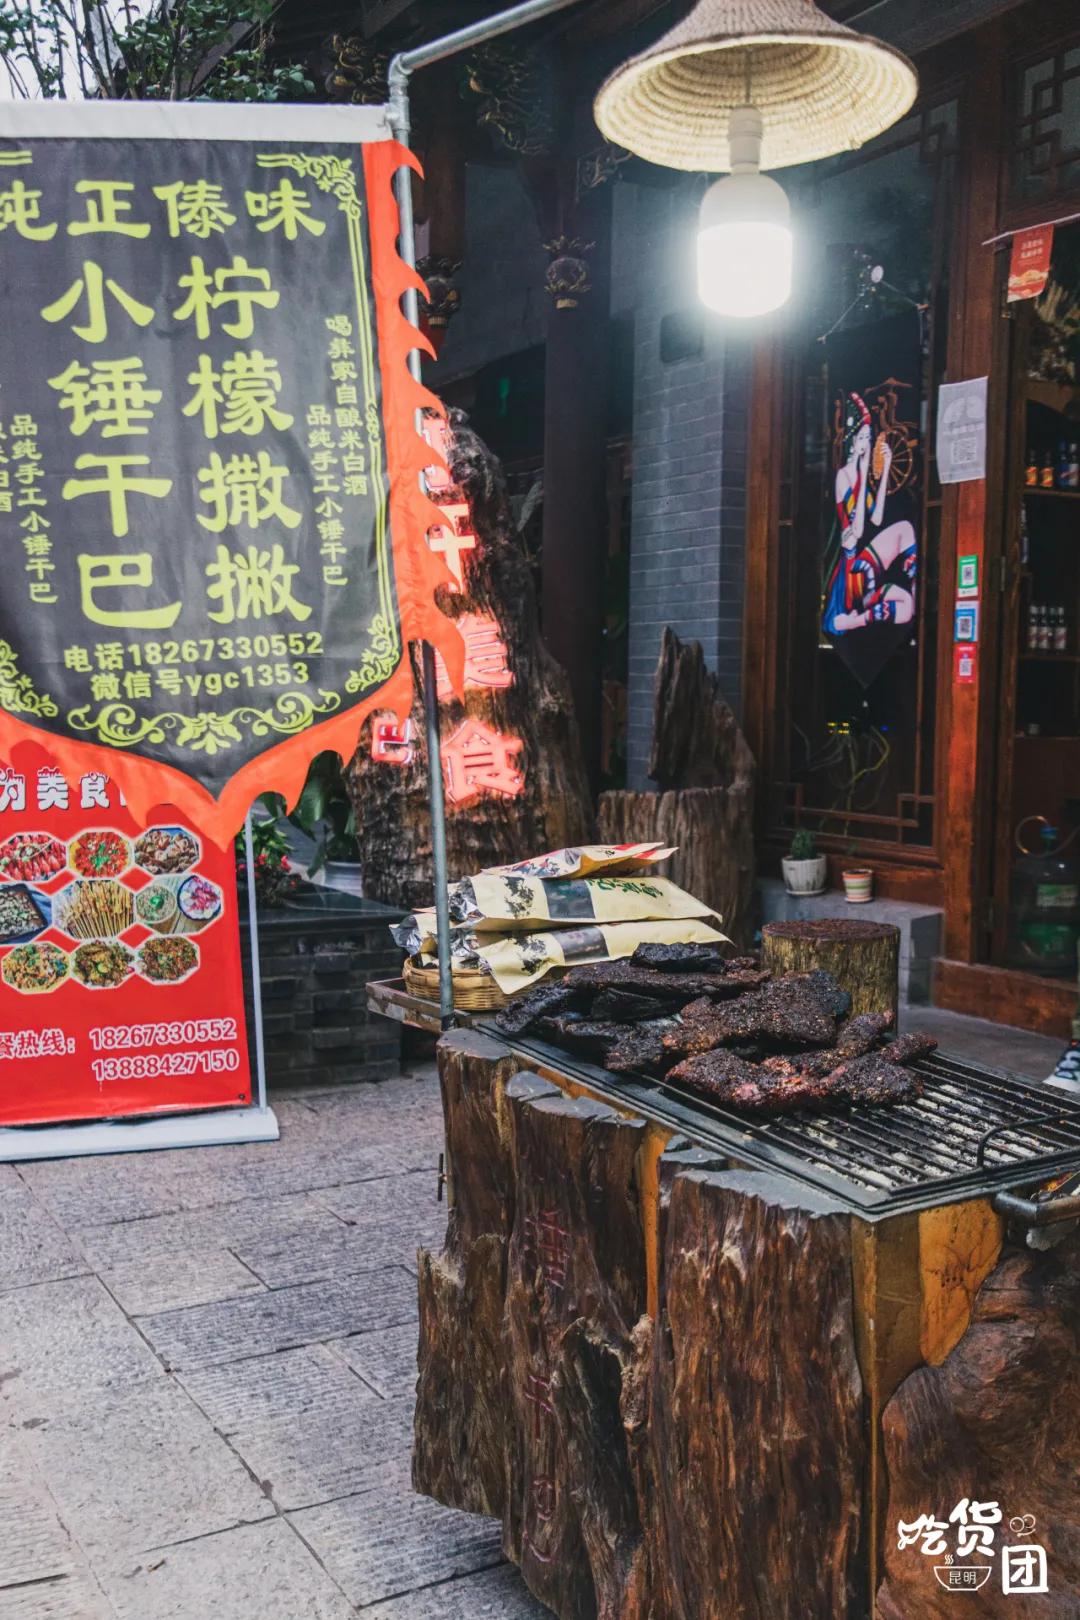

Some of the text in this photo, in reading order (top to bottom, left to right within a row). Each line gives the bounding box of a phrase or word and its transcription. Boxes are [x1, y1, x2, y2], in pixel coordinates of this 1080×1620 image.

[0, 178, 326, 241] 纯正傣味
[40, 260, 183, 629] 小锤干巴
[10, 414, 58, 604] 品纯手工小锤干巴
[307, 405, 348, 586] 品纯手工小锤干巴
[64, 632, 324, 673] 电话18267330552
[91, 662, 309, 701] 微信号ygc1353
[89, 1017, 237, 1051] 18267330552
[92, 1049, 240, 1081] 13888427150
